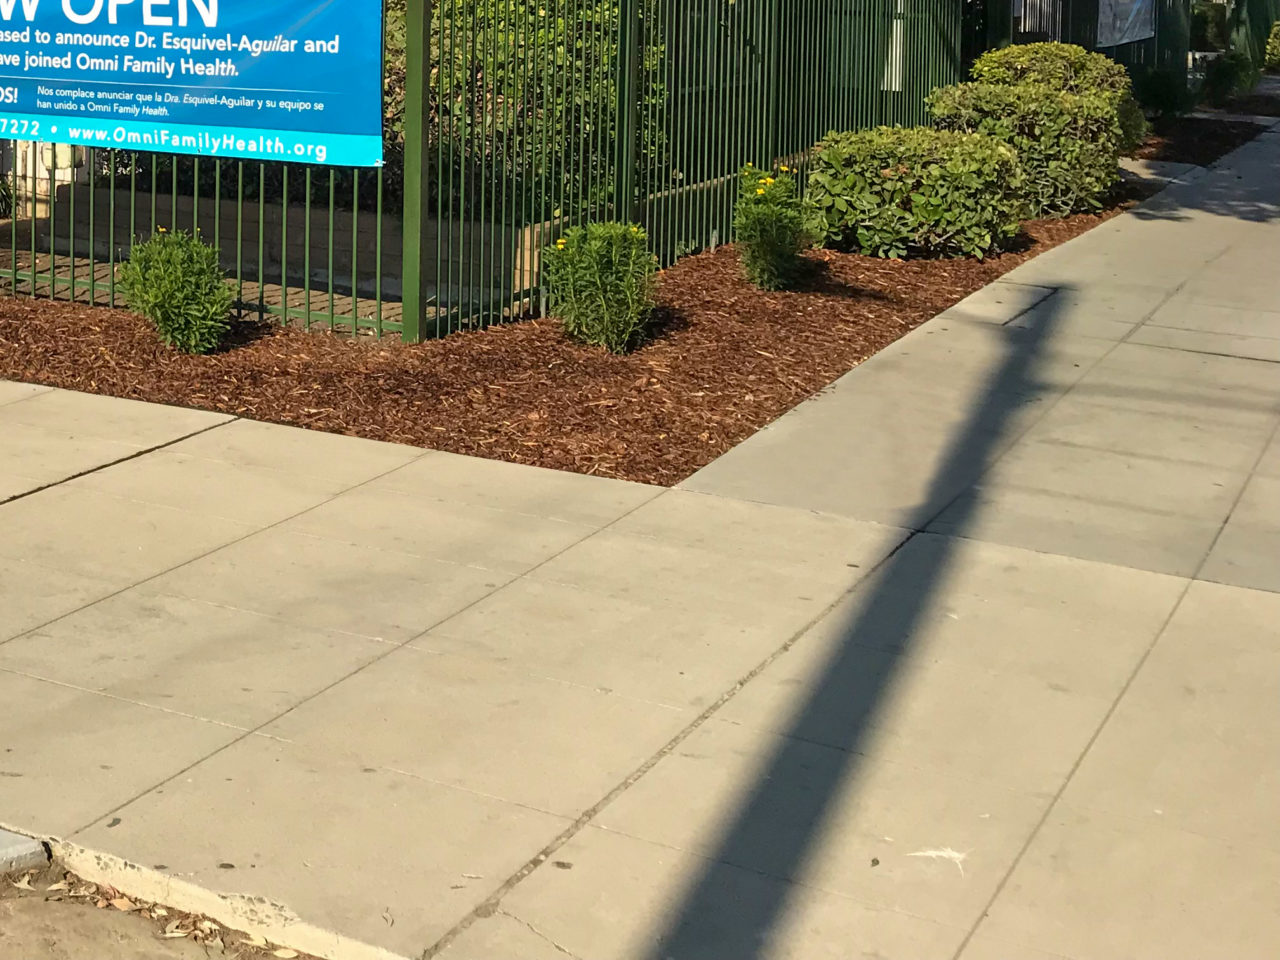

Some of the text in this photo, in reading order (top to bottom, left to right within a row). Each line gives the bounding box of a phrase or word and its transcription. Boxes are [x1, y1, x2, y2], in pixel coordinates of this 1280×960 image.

[35, 29, 51, 44] to
[55, 32, 130, 47] announce
[135, 31, 156, 48] Dr.
[162, 32, 298, 56] Esquivel-Aguilar
[304, 35, 339, 53] and
[24, 50, 71, 71] joined
[76, 53, 119, 71] Omni
[123, 55, 175, 79] Family
[180, 58, 239, 76] Health.
[37, 86, 324, 112] Nos complace anunciar que la Dra. Esquivel-Aguilar y su equipo se
[37, 99, 170, 117] han unido a Omni Family Health.
[68, 126, 327, 162] www.OmniFamilyHealth.org
